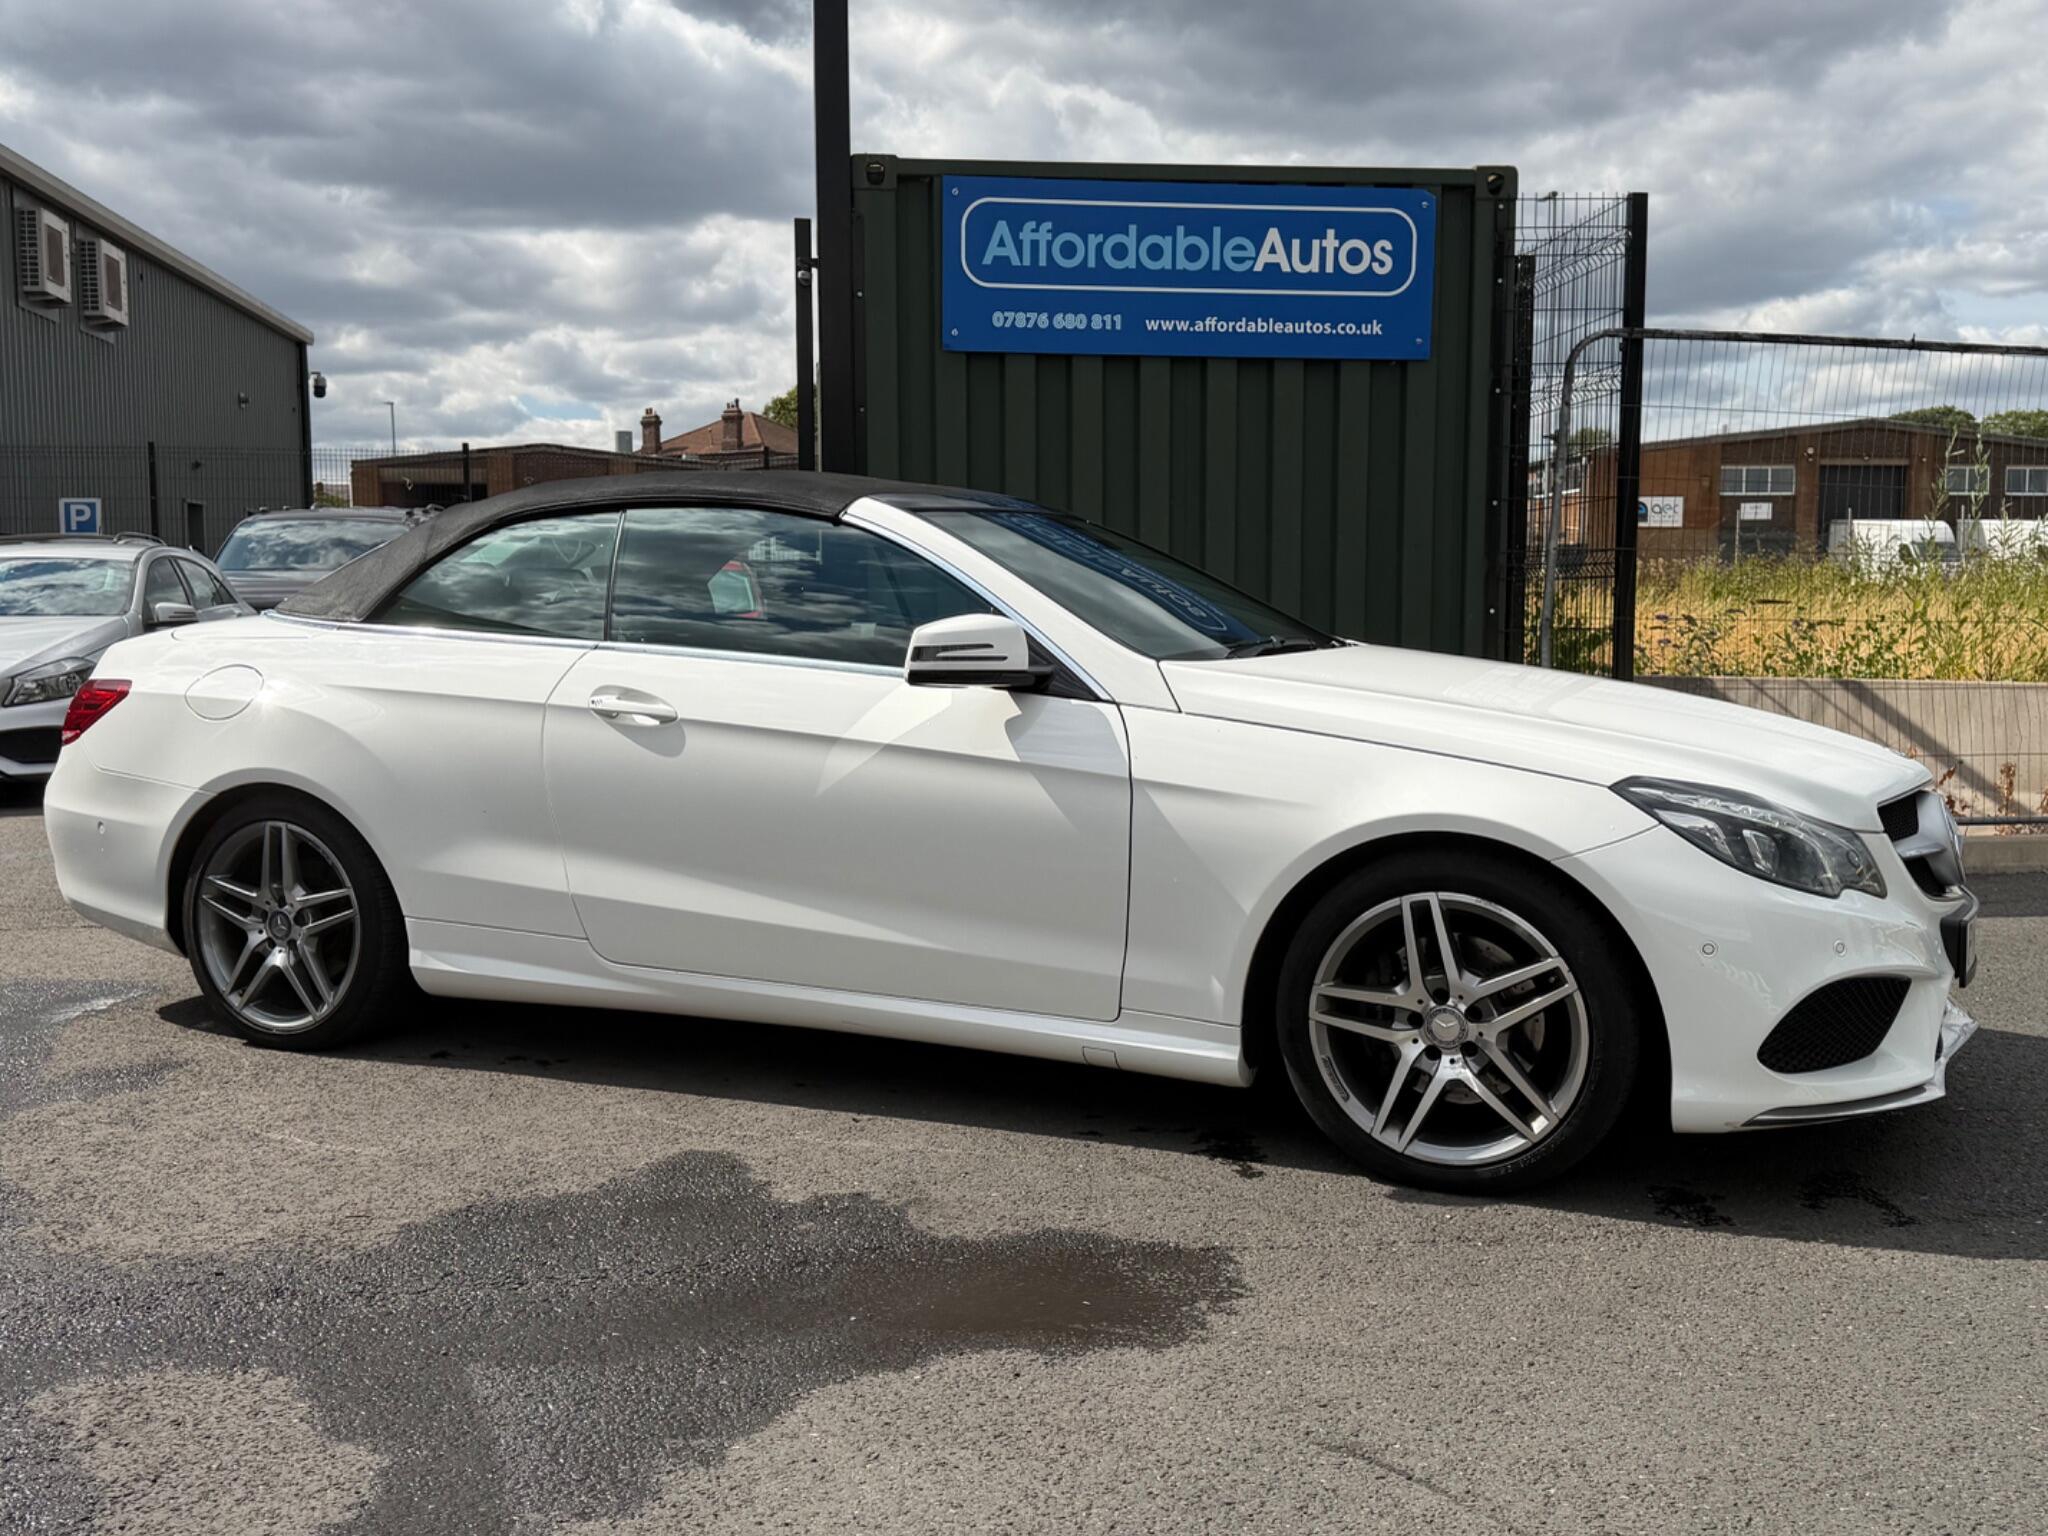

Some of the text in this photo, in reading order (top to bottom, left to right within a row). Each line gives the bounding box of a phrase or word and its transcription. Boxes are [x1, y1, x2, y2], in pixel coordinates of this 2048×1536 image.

[991, 310, 1383, 337] 07876 680 811 www.affordableautos.co.uk
[70, 504, 91, 531] P
